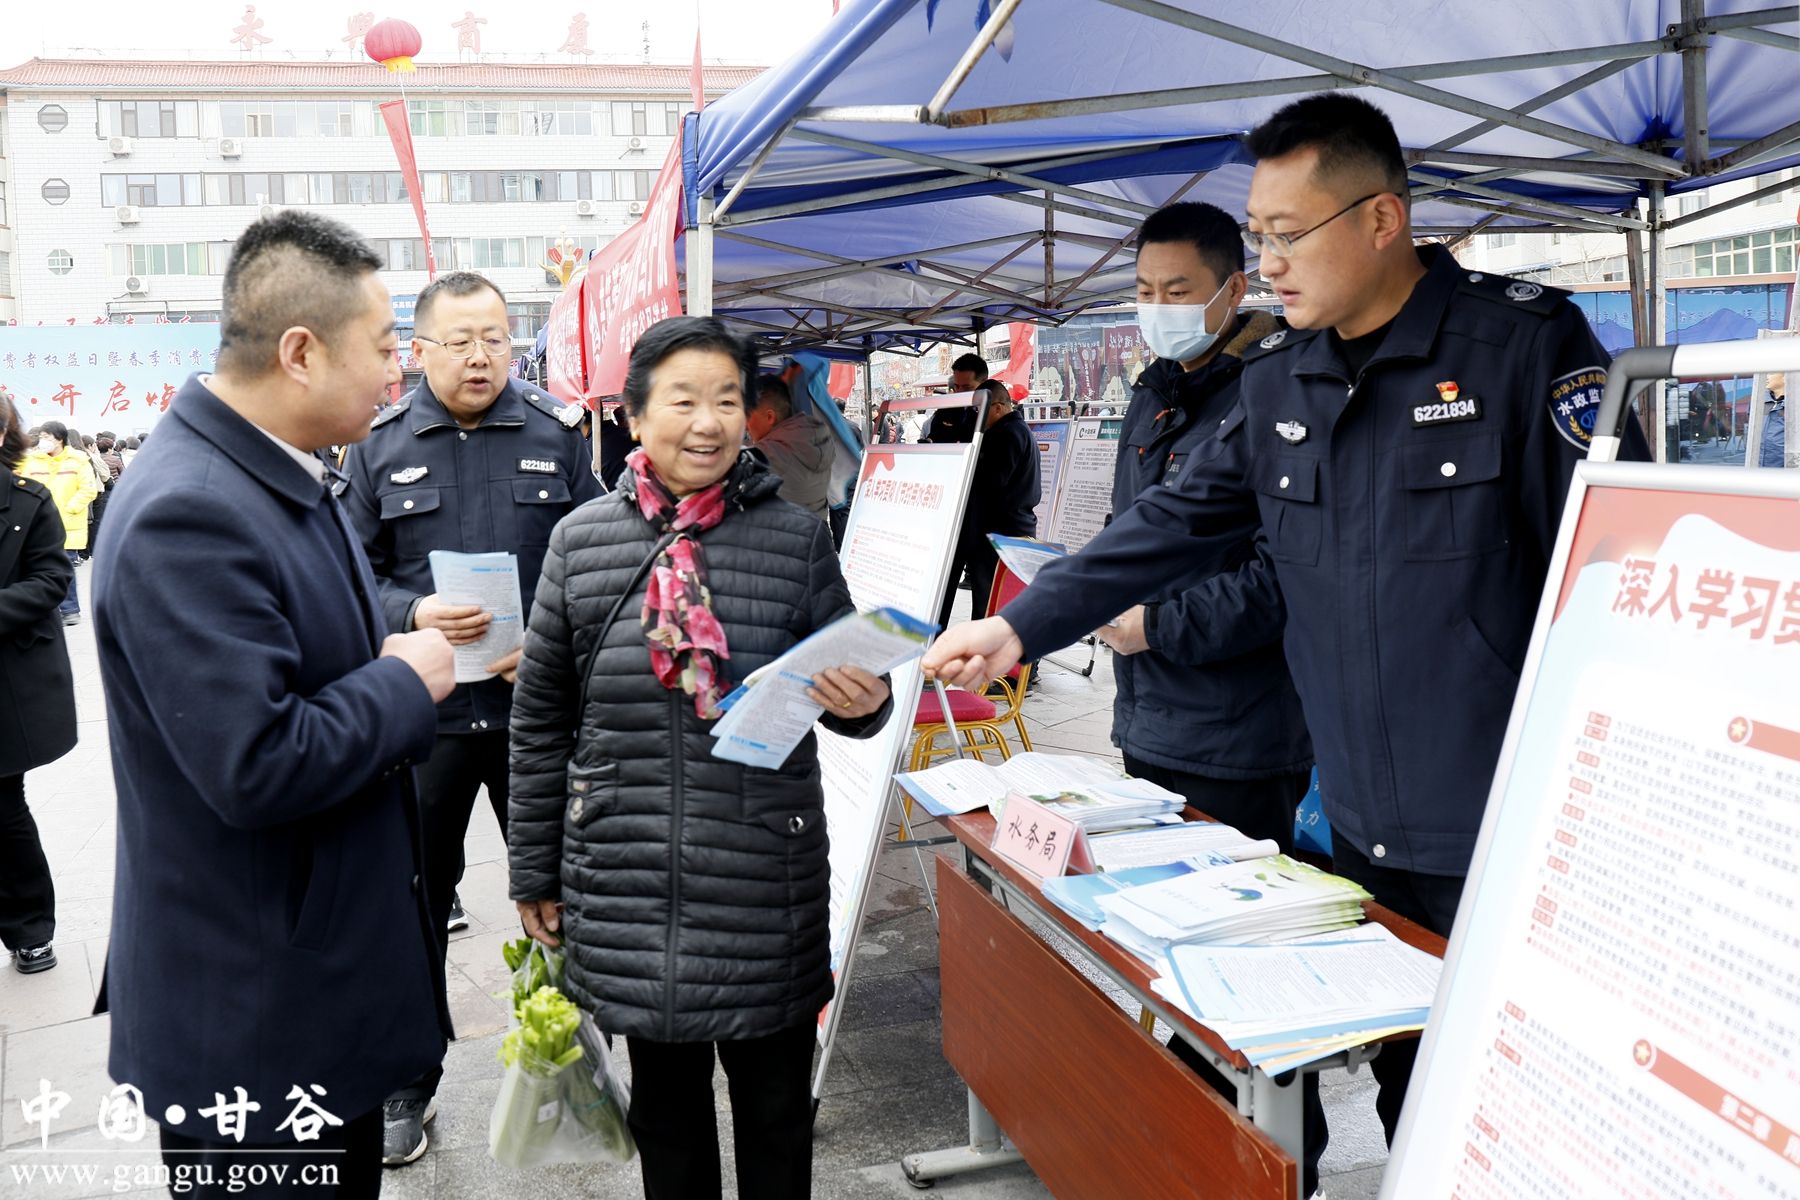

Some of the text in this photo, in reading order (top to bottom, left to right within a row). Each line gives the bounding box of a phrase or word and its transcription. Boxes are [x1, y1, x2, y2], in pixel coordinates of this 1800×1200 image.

[1414, 399, 1476, 422] 6221834
[1557, 388, 1604, 416] 水政监
[521, 459, 555, 471] 6221816
[1008, 814, 1057, 861] 水务局
